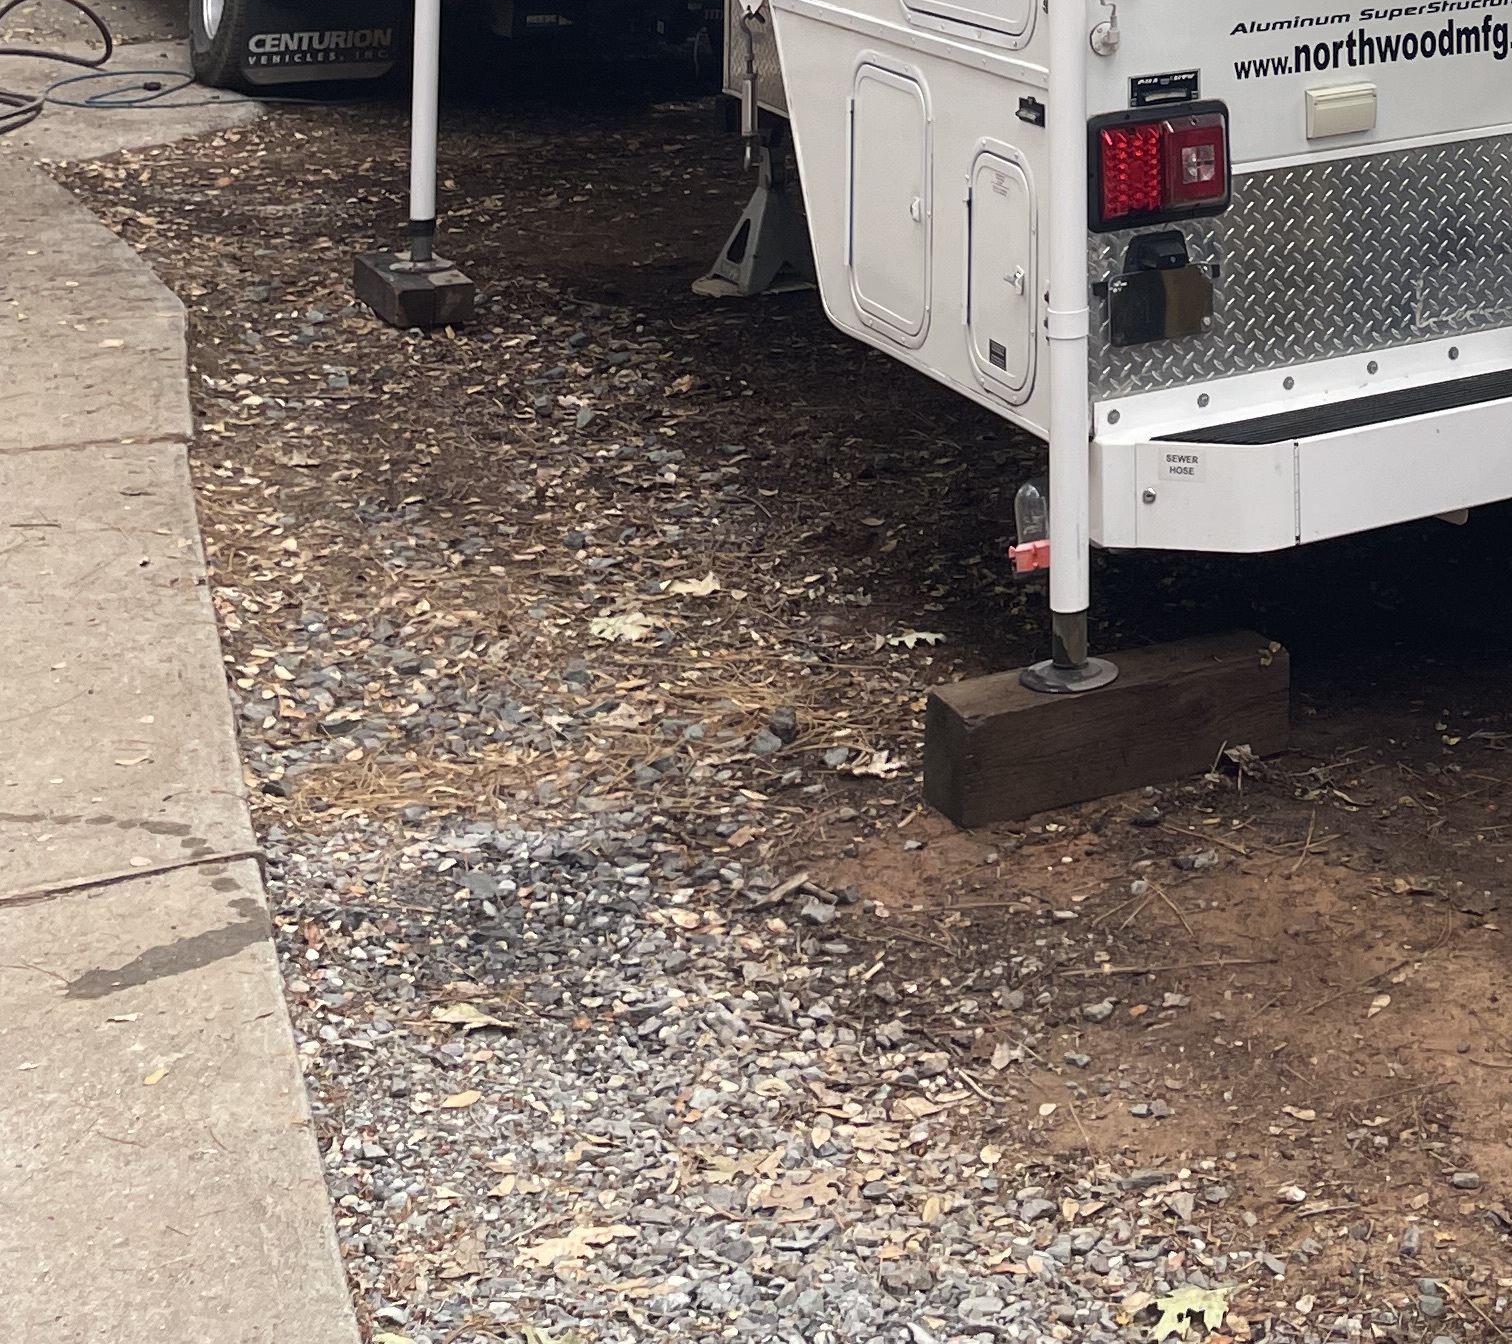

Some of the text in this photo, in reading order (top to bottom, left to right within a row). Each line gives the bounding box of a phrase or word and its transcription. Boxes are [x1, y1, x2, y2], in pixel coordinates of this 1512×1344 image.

[1230, 12, 1351, 36] Aluminum
[248, 28, 393, 53] CENTURION
[1166, 454, 1199, 464] SEWER
[1169, 466, 1195, 475] HOSE
